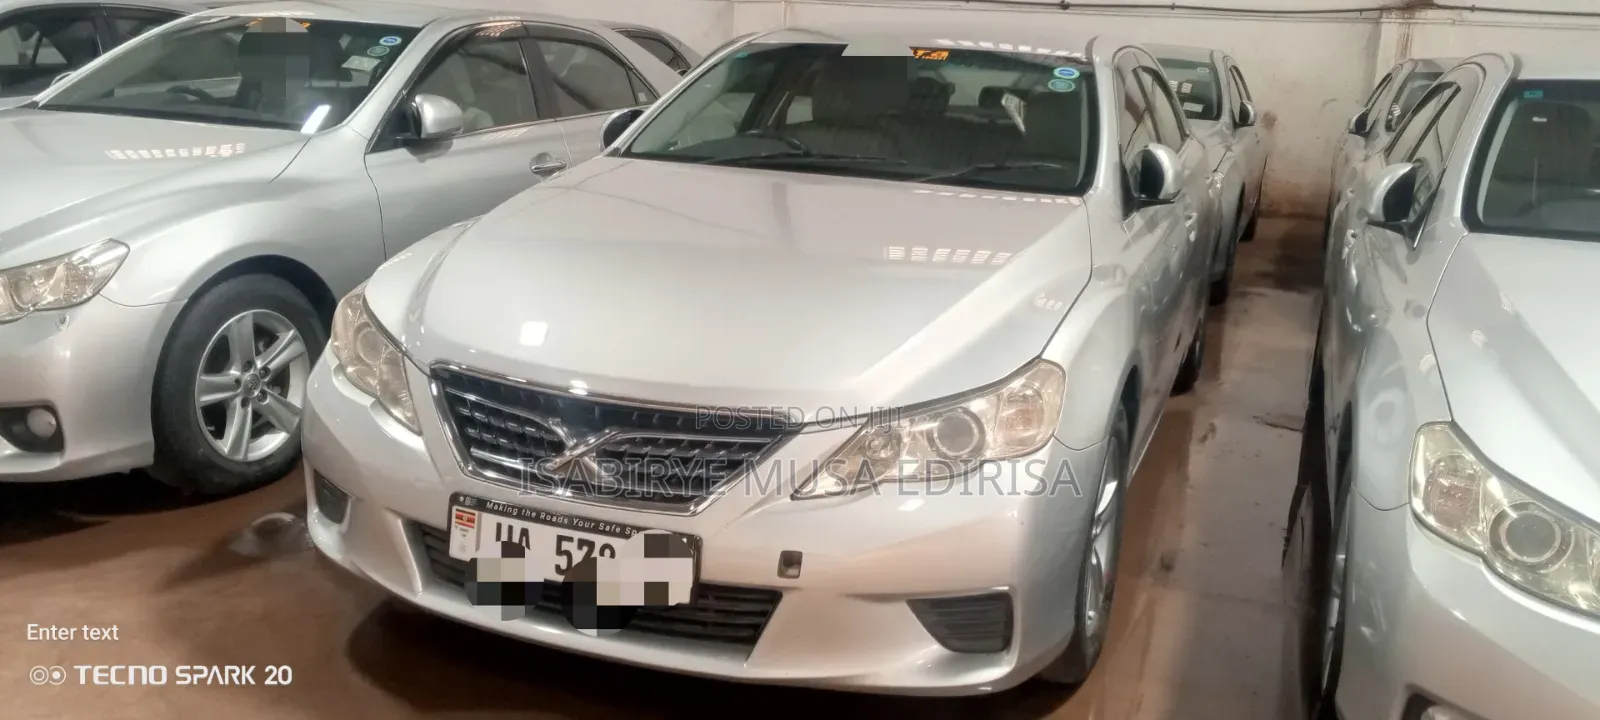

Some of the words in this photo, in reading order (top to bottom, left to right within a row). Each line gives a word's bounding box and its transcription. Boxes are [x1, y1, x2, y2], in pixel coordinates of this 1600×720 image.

[485, 501, 519, 516] Making
[521, 508, 537, 518] the
[539, 512, 569, 524] Roads
[572, 517, 595, 529] Your
[598, 522, 621, 533] Safe
